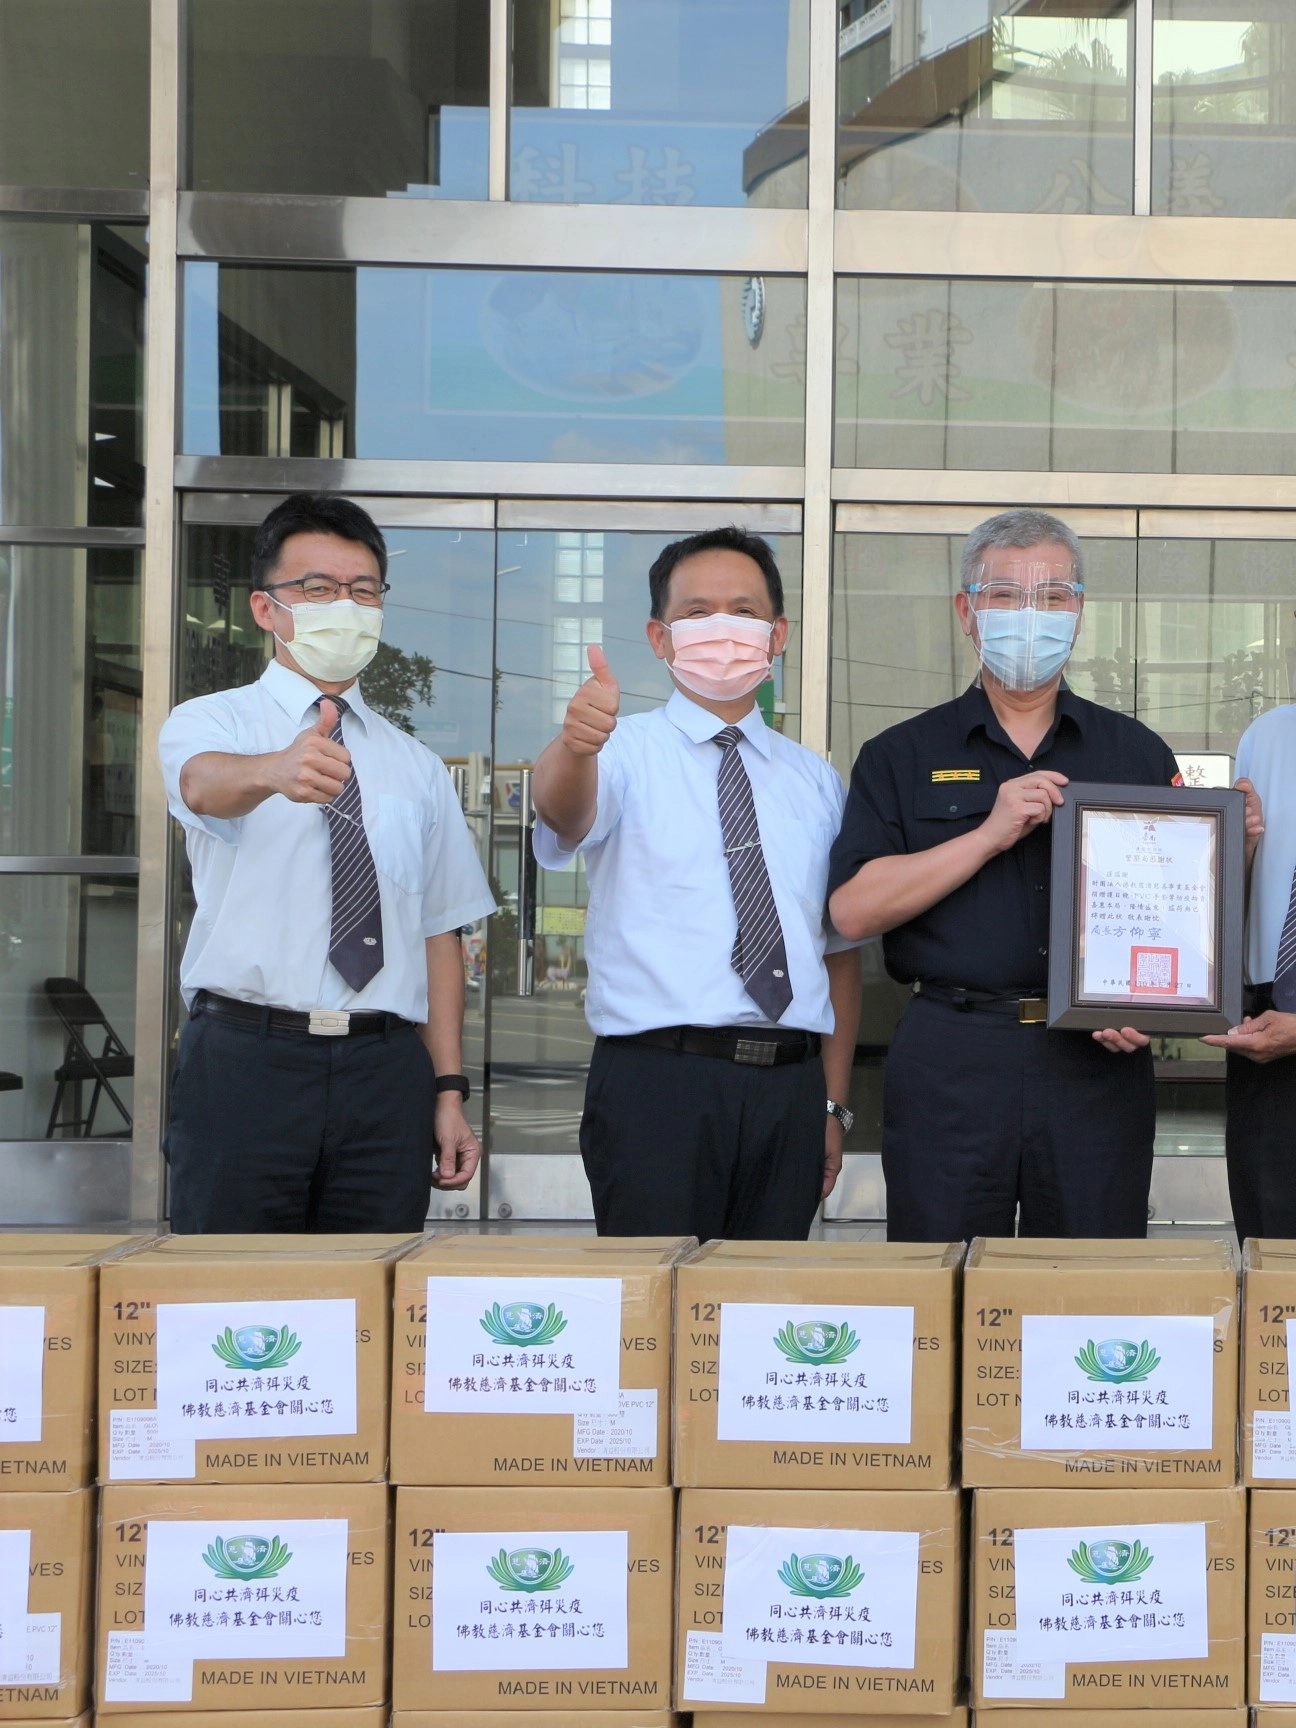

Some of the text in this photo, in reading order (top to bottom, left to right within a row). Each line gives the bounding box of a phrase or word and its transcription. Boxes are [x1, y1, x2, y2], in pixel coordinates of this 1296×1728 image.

[113, 1302, 150, 1320] 12"
[976, 1309, 1013, 1327] 12"
[1259, 1305, 1295, 1323] 12"
[977, 1367, 1019, 1379] SIZE:
[449, 1377, 597, 1393] 佛教慈濟基金會關心您
[114, 1388, 147, 1401] LOT
[977, 1393, 1009, 1406] LOT
[1259, 1389, 1289, 1402] LOT
[182, 1399, 334, 1418] 佛教慈濟基金會關心您
[742, 1396, 889, 1412] 佛教慈濟基金會關心您
[1045, 1414, 1190, 1429] 佛教慈濟基金會關心您
[206, 1452, 369, 1467] MADE IN VIETNAM
[494, 1458, 653, 1472] MADE IN VIETNAM
[774, 1451, 931, 1468] MADE IN VIETNAM
[1066, 1460, 1221, 1473] MADE IN VIETNAM
[169, 1611, 322, 1627] 佛教慈濟基金會關心您
[1039, 1612, 1185, 1632] 佛教慈濟基金會關心您
[1265, 1613, 1296, 1626] LOT
[457, 1623, 605, 1639] 佛教慈濟基金會關心您
[746, 1627, 892, 1647] 佛教慈濟基金會關心您
[202, 1670, 366, 1684] MADE IN VIETNAM
[777, 1674, 934, 1692] MADE IN VIETNAM
[1072, 1674, 1229, 1688] MADE IN VIETNAM
[499, 1681, 657, 1695] MADE IN VIETNAM
